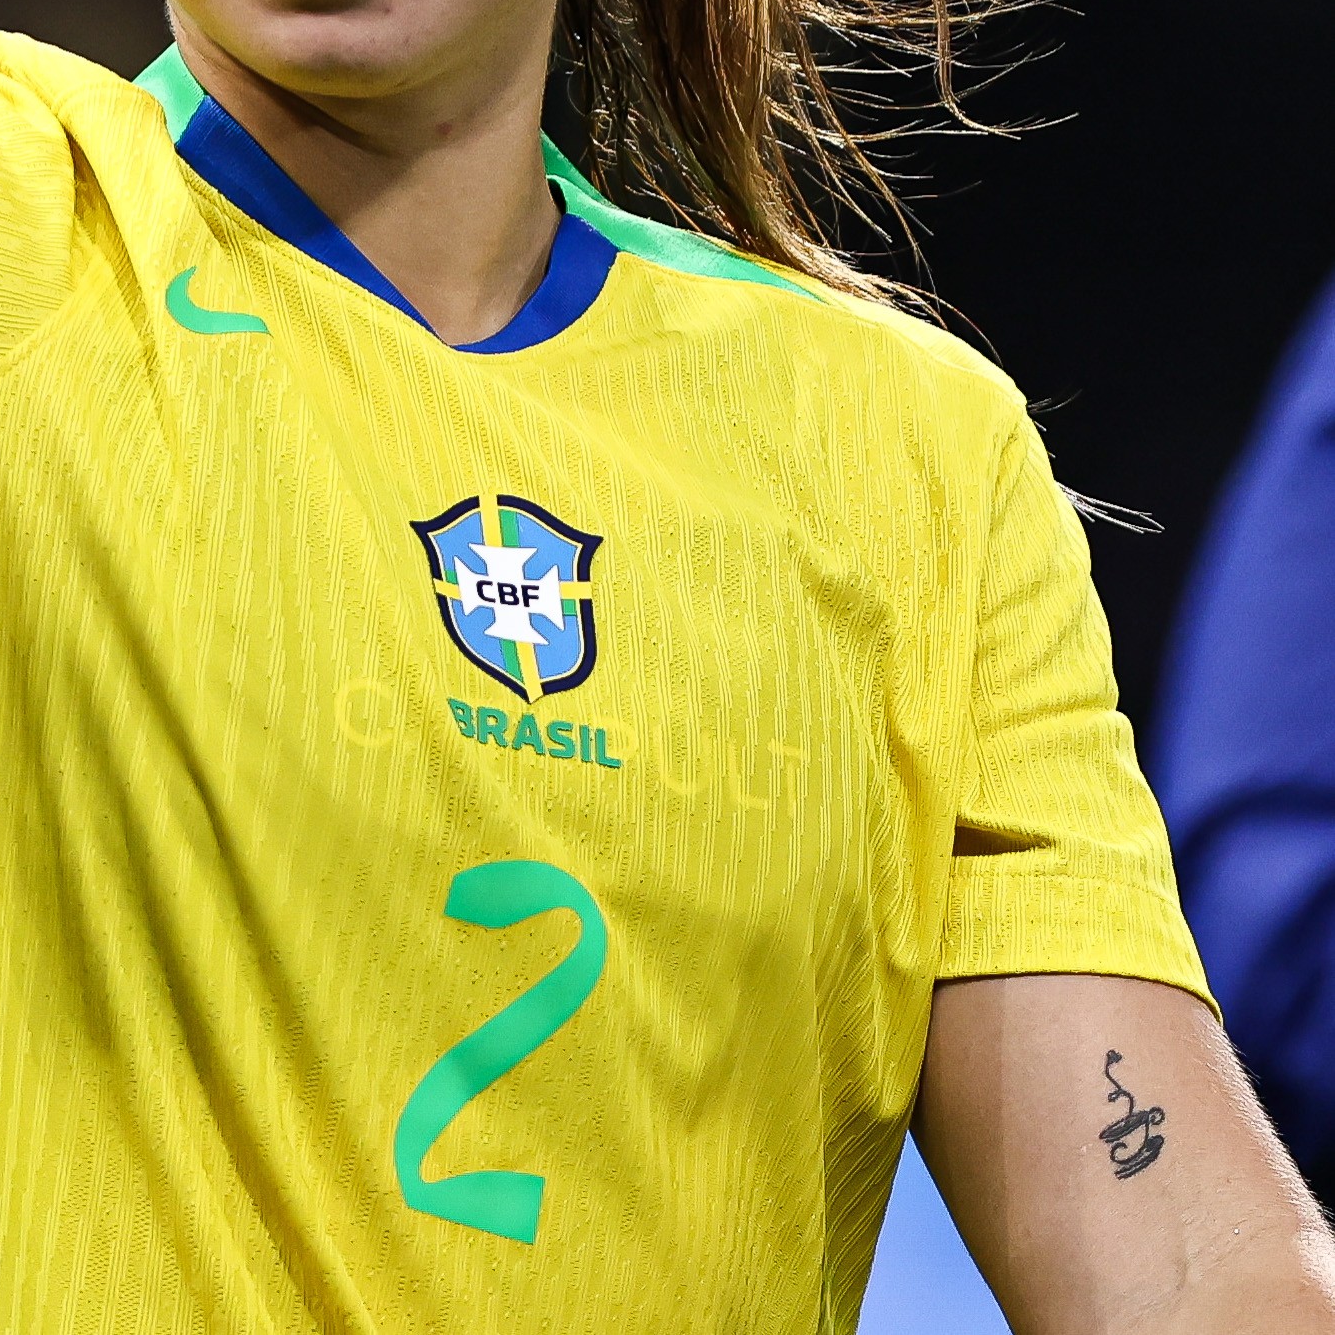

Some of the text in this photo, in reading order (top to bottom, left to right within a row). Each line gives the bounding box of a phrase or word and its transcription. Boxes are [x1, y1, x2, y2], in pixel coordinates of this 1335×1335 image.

[476, 580, 540, 607] CBF
[447, 697, 623, 769] BRASIL
[394, 859, 608, 1246] 2
